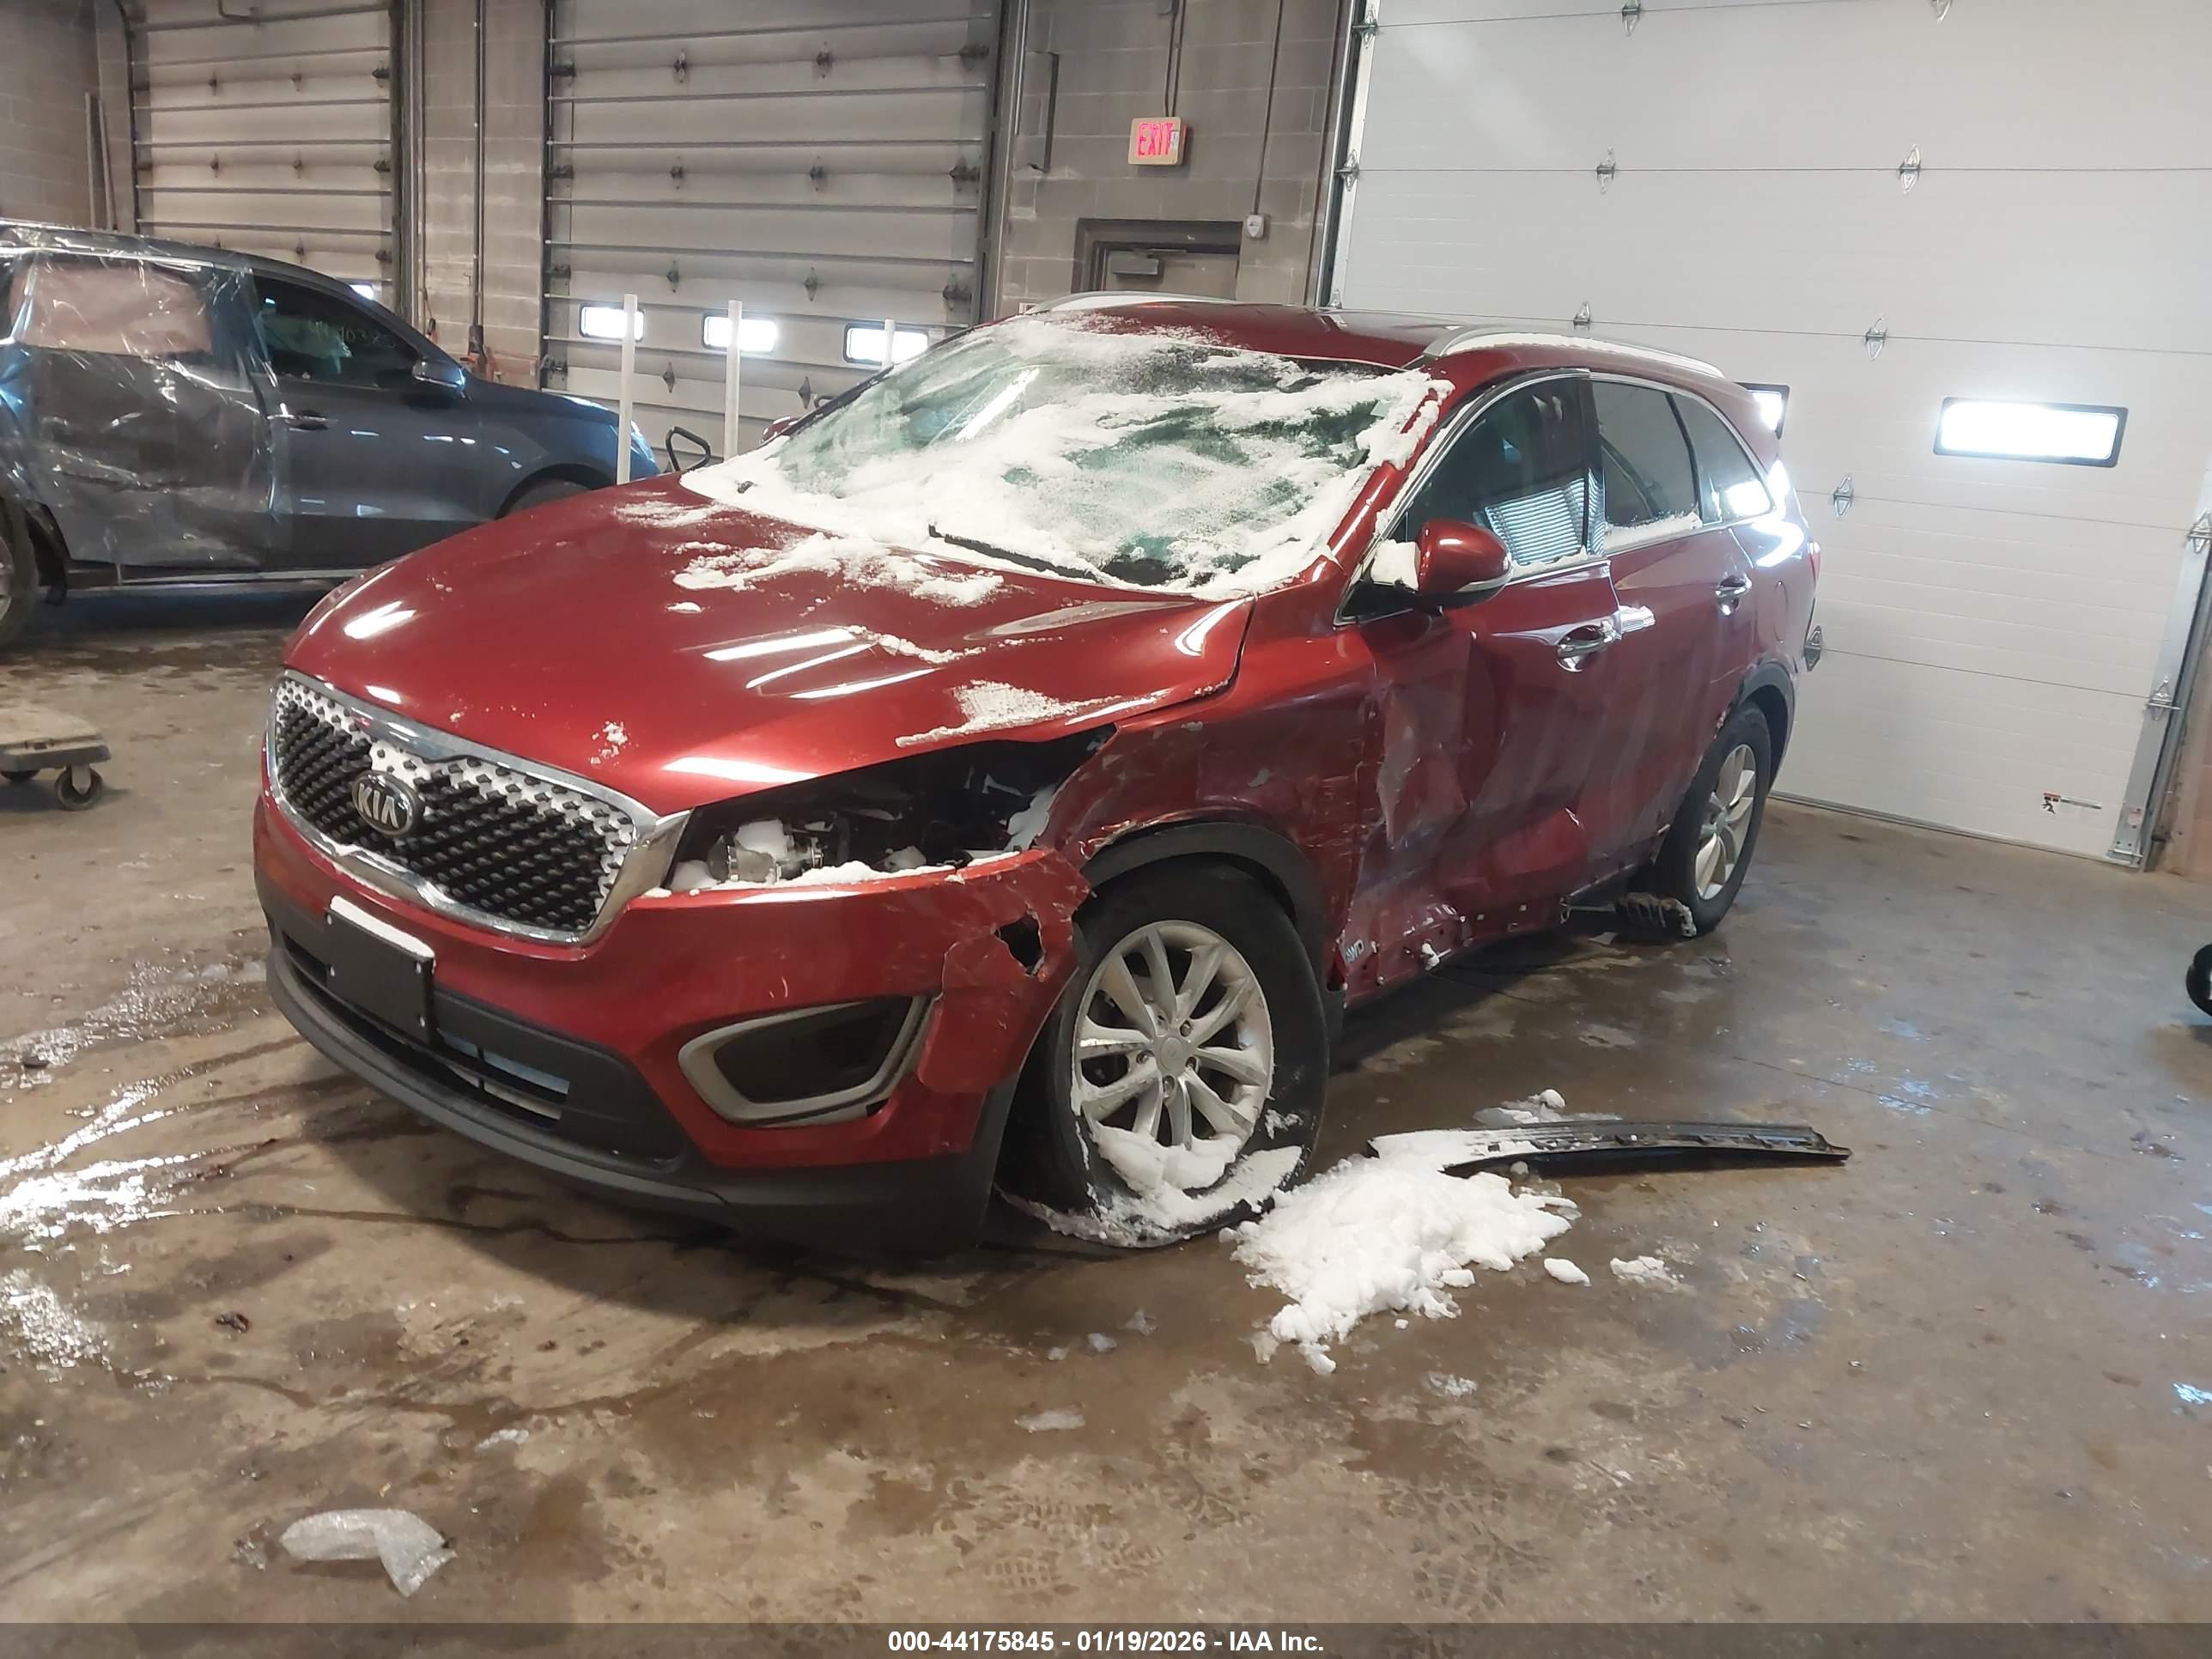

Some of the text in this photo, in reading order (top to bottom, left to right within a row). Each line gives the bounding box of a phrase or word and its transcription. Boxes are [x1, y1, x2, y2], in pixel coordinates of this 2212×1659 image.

[1138, 123, 1174, 155] EXIT
[358, 782, 399, 829] KIA
[1345, 939, 1364, 963] AWD
